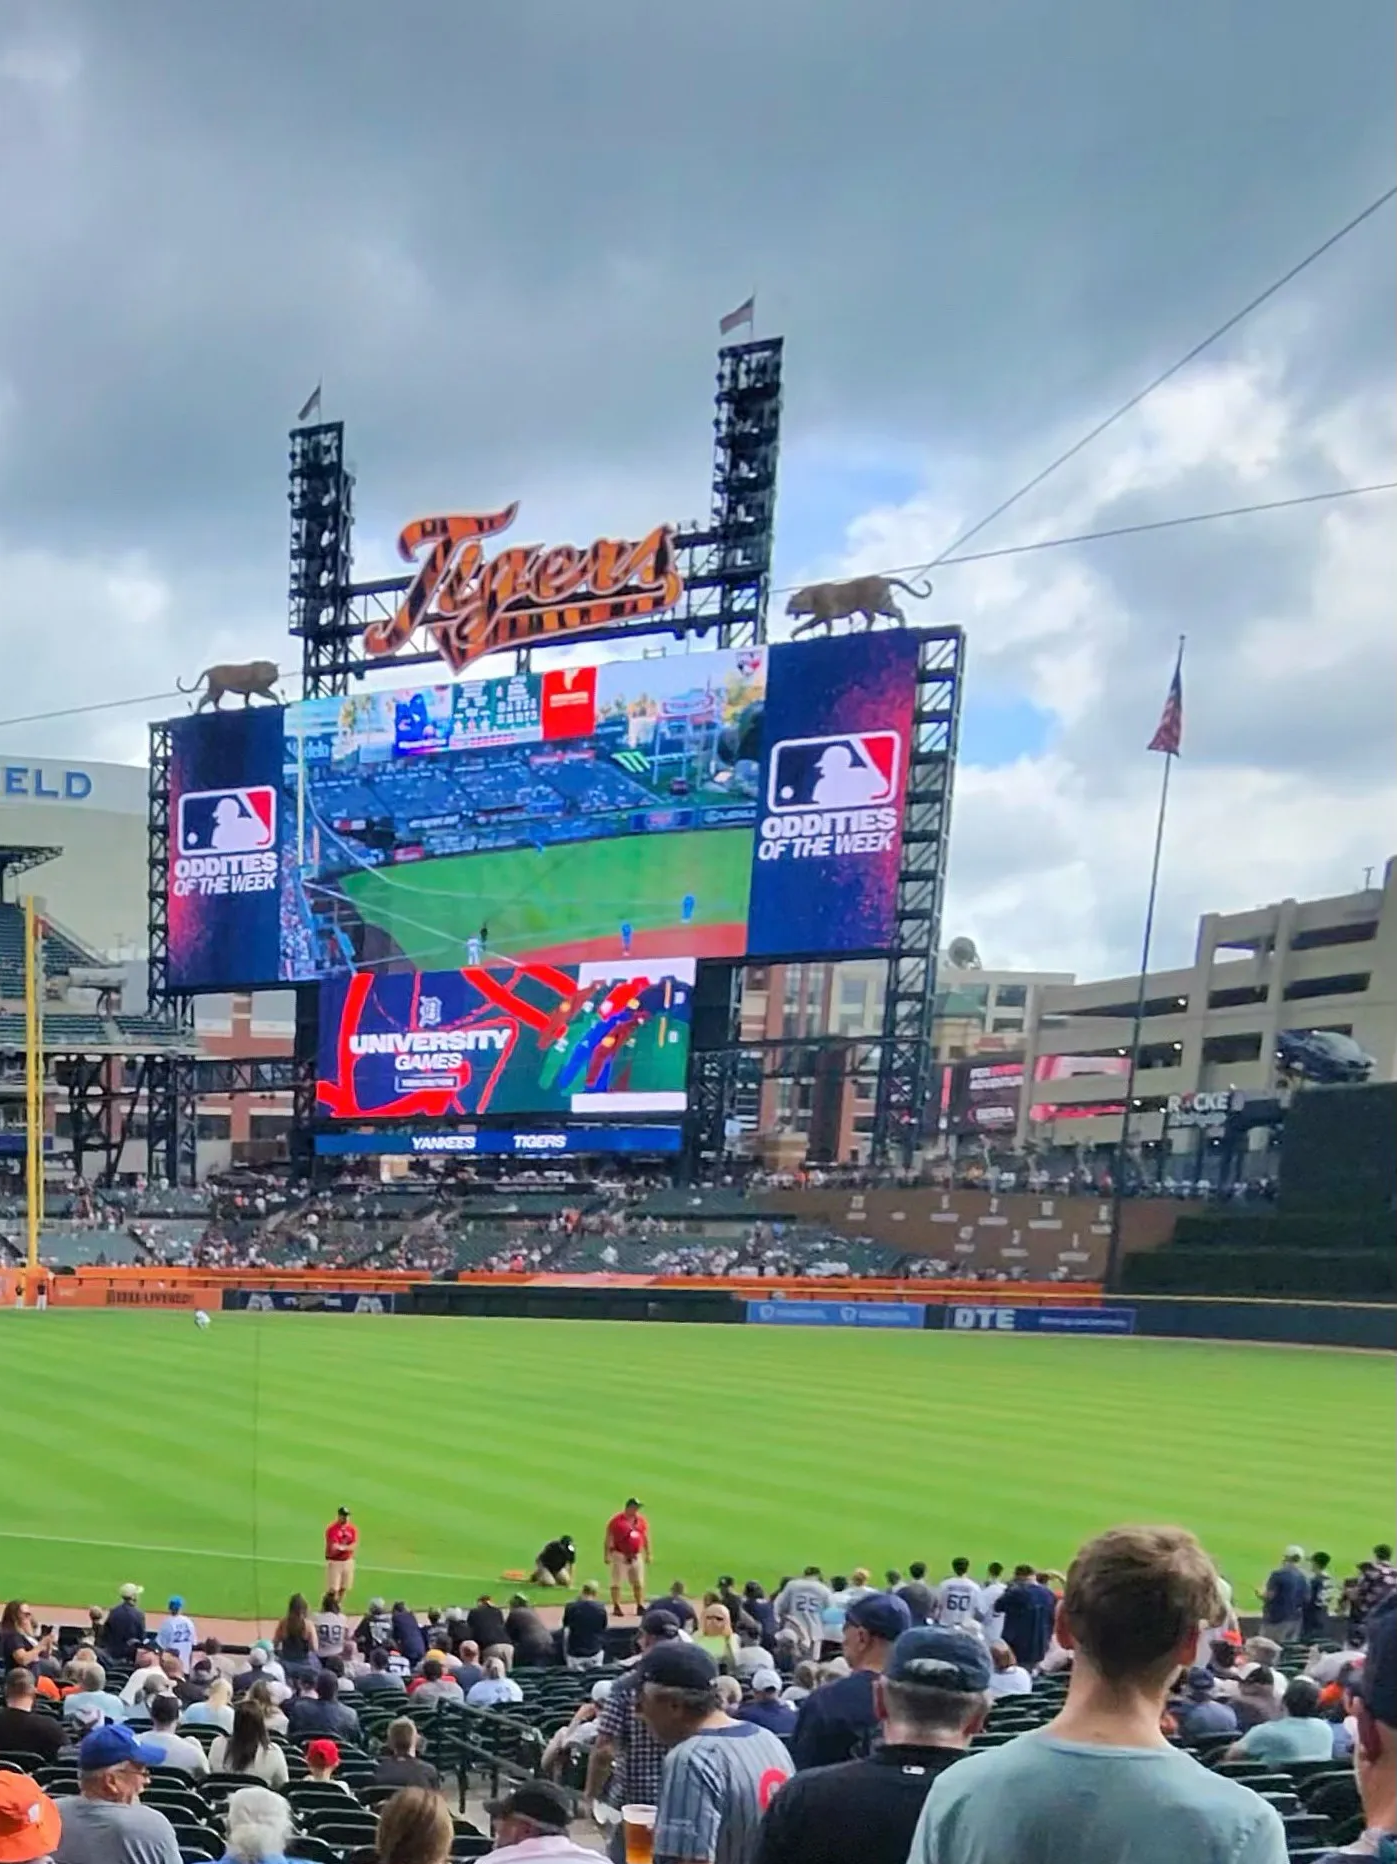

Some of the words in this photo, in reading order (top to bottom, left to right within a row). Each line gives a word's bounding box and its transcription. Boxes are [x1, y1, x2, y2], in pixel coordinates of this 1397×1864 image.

[363, 500, 684, 676] Tigers
[760, 807, 898, 840] ODDITIES
[758, 838, 789, 861] OF
[791, 835, 834, 858] THE
[834, 831, 896, 855] WEEK
[173, 851, 278, 879] ODDITIES
[173, 878, 199, 897] OF
[198, 875, 230, 896] THE
[229, 872, 278, 894] WEEK
[349, 1028, 512, 1054] UNIVERSITY
[394, 1052, 463, 1072] GAMES
[412, 1134, 477, 1150] YANKEES
[513, 1133, 567, 1149] TIGERS
[954, 1307, 1017, 1330] DTE
[947, 1594, 971, 1612] 60
[173, 1629, 191, 1643] 22
[318, 1624, 342, 1642] 99
